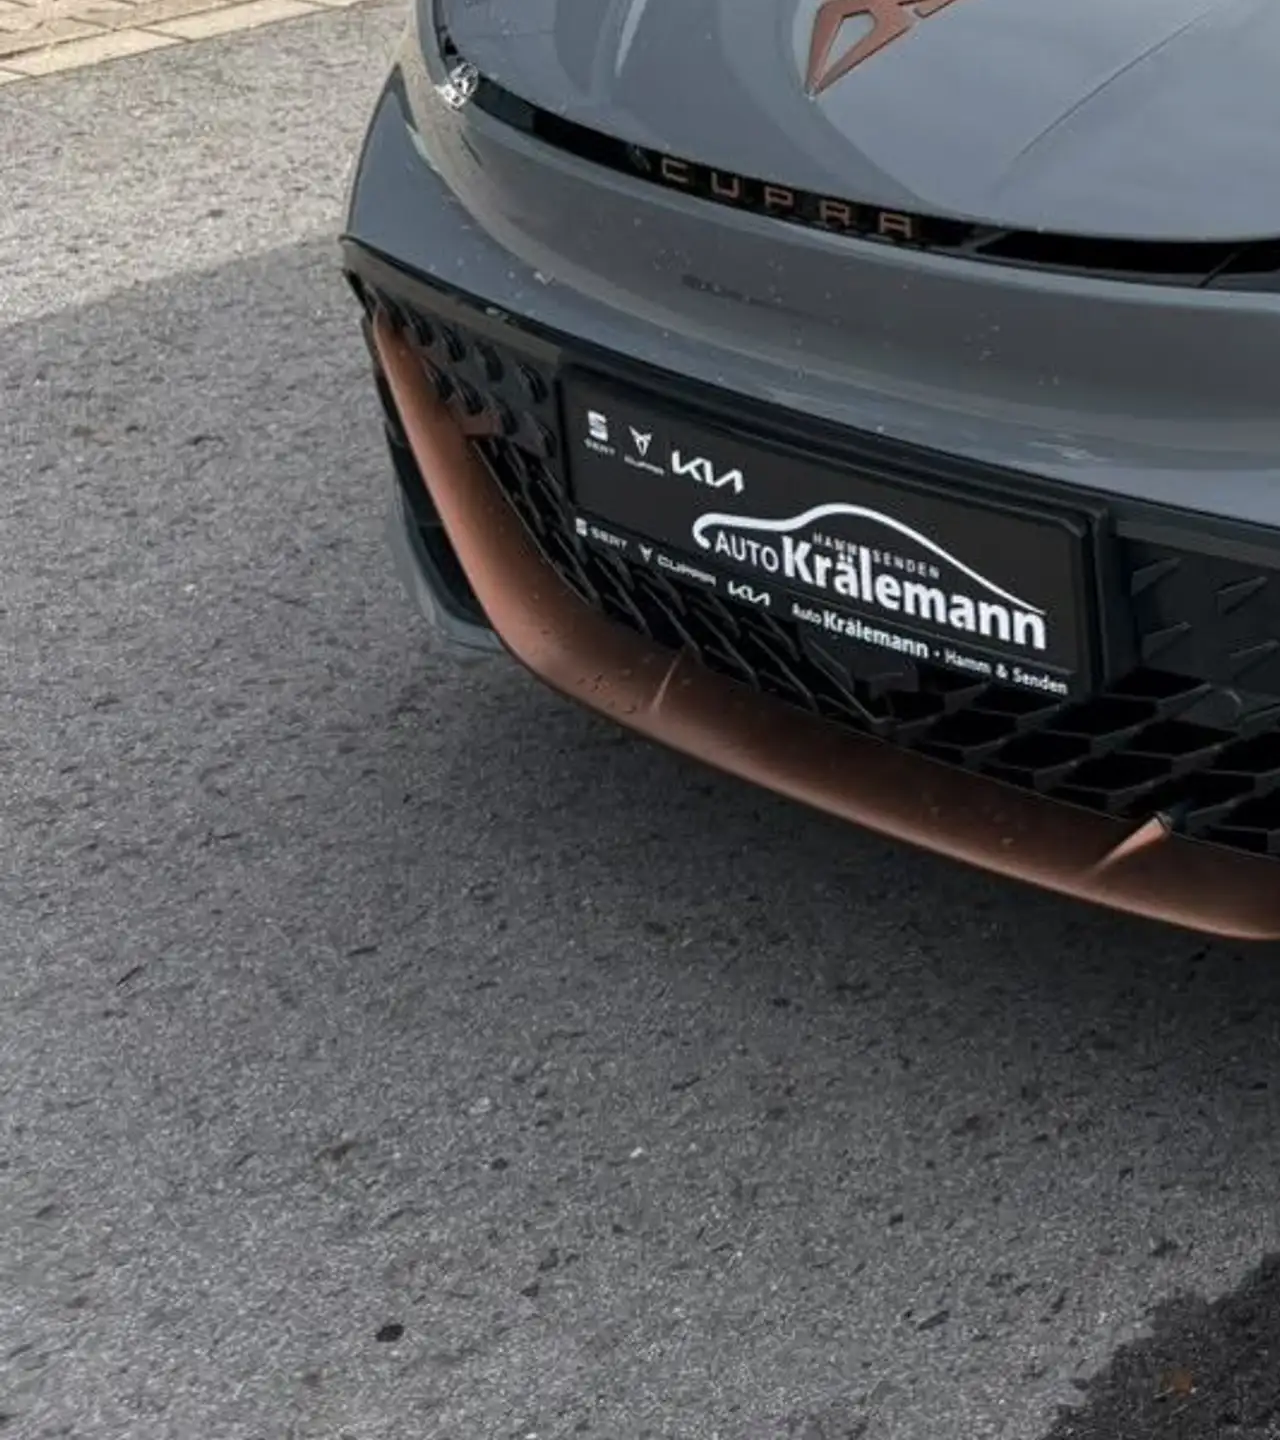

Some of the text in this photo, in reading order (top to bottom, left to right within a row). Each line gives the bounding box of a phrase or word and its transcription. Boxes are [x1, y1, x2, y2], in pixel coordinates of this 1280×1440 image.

[661, 157, 913, 241] CUPRA
[715, 529, 1048, 651] AUTO Krälemann
[1011, 668, 1069, 696] Senden
